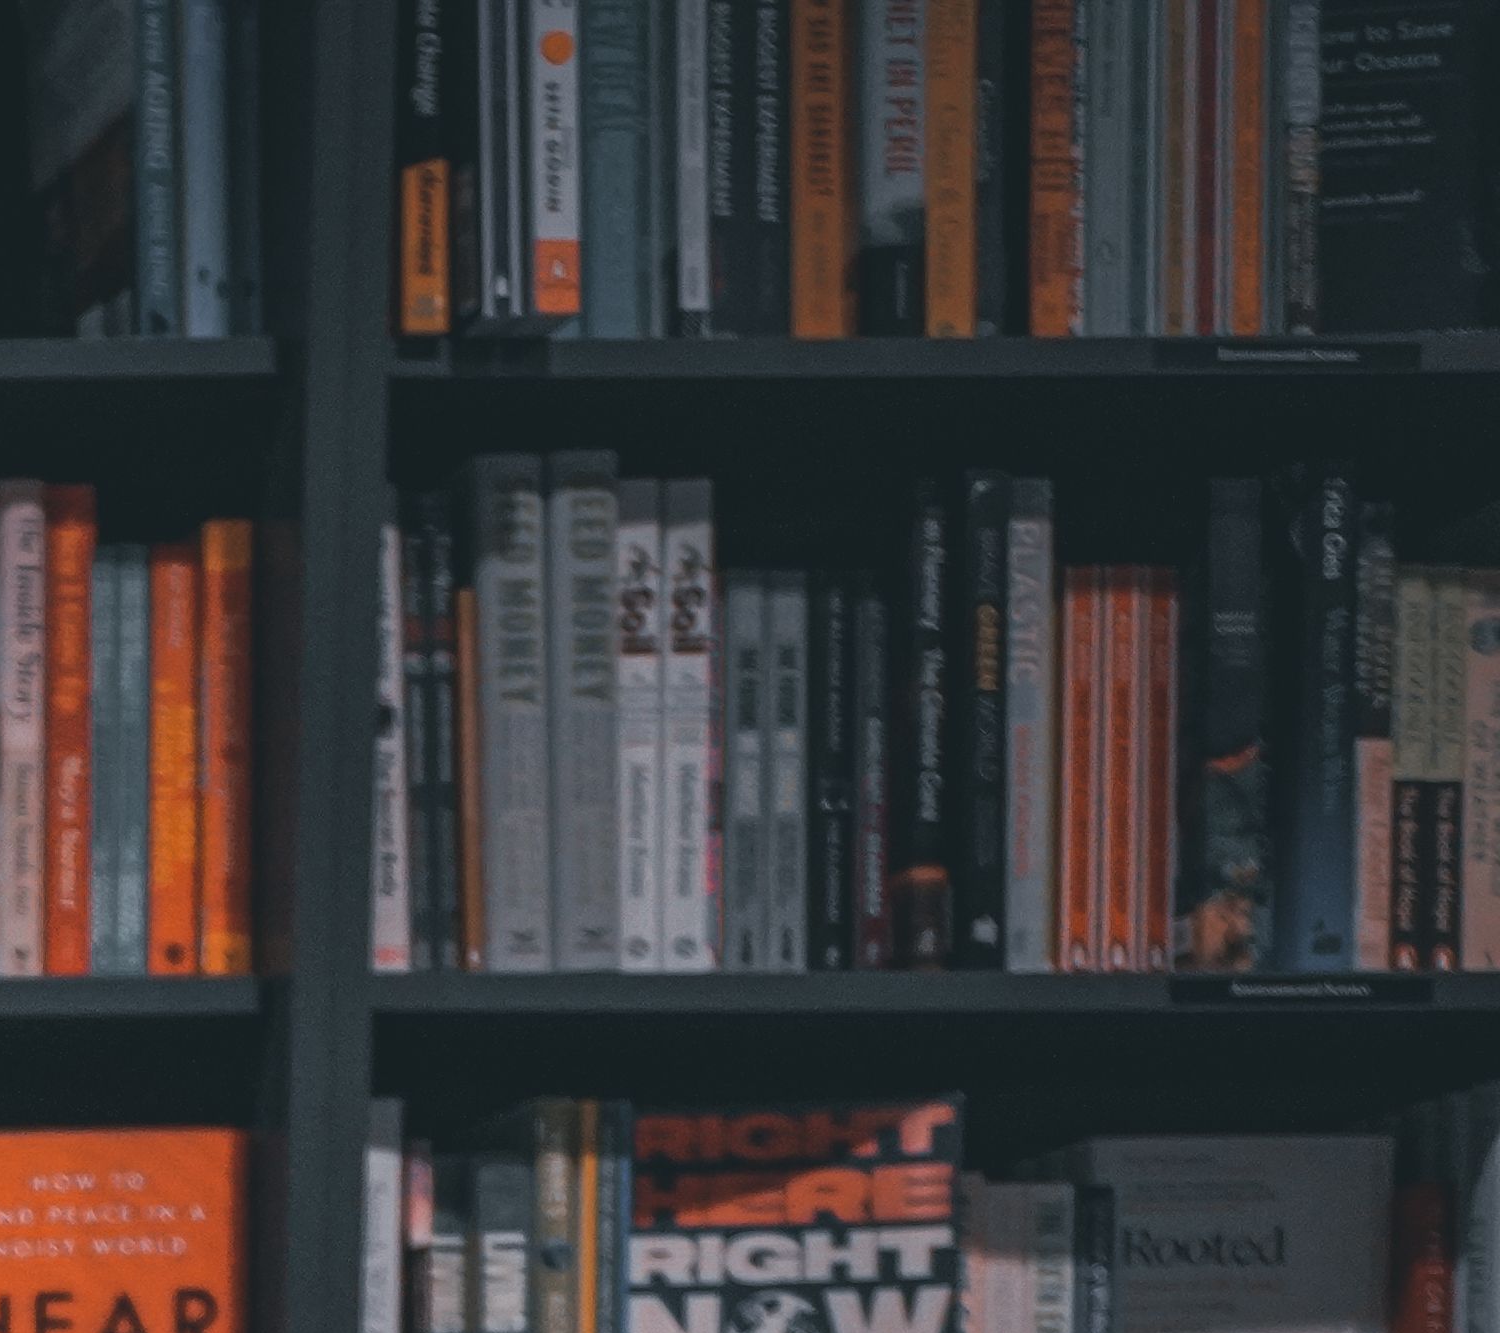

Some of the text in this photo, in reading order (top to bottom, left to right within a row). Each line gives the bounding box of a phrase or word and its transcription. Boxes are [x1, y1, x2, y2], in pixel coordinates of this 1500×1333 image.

[712, 91, 731, 218] EXPERIMENT
[757, 95, 776, 224] EXPERIMENT
[885, 96, 916, 179] PERIL
[623, 585, 656, 655] Soil
[672, 585, 704, 655] Soil
[1010, 520, 1040, 686] PLASTIC
[636, 1103, 959, 1158] RIGHT
[46, 1203, 132, 1225] PEACE
[91, 1236, 187, 1257] WORLD
[1120, 1225, 1288, 1271] Rooted
[636, 1225, 953, 1281] RIGHT
